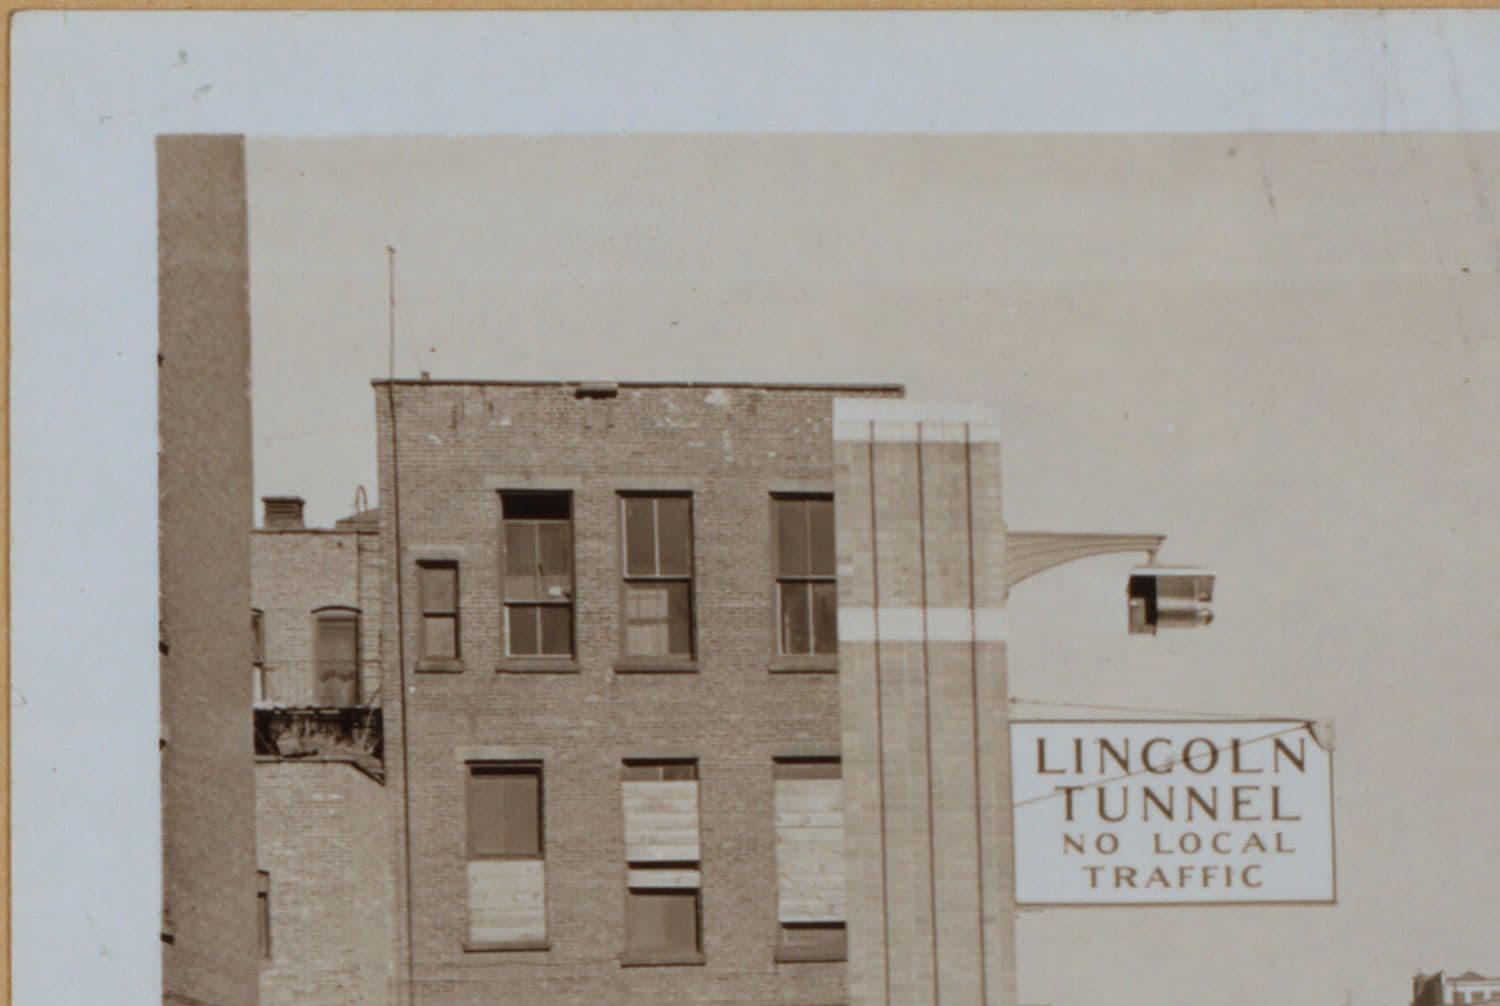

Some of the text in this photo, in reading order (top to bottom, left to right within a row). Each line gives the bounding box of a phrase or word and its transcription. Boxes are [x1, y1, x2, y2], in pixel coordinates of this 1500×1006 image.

[1036, 738, 1305, 775] LINCOLN
[1054, 786, 1301, 823] TUNNEL
[1063, 832, 1295, 855] NO LOCAL
[1083, 865, 1263, 889] TRAFFIC
